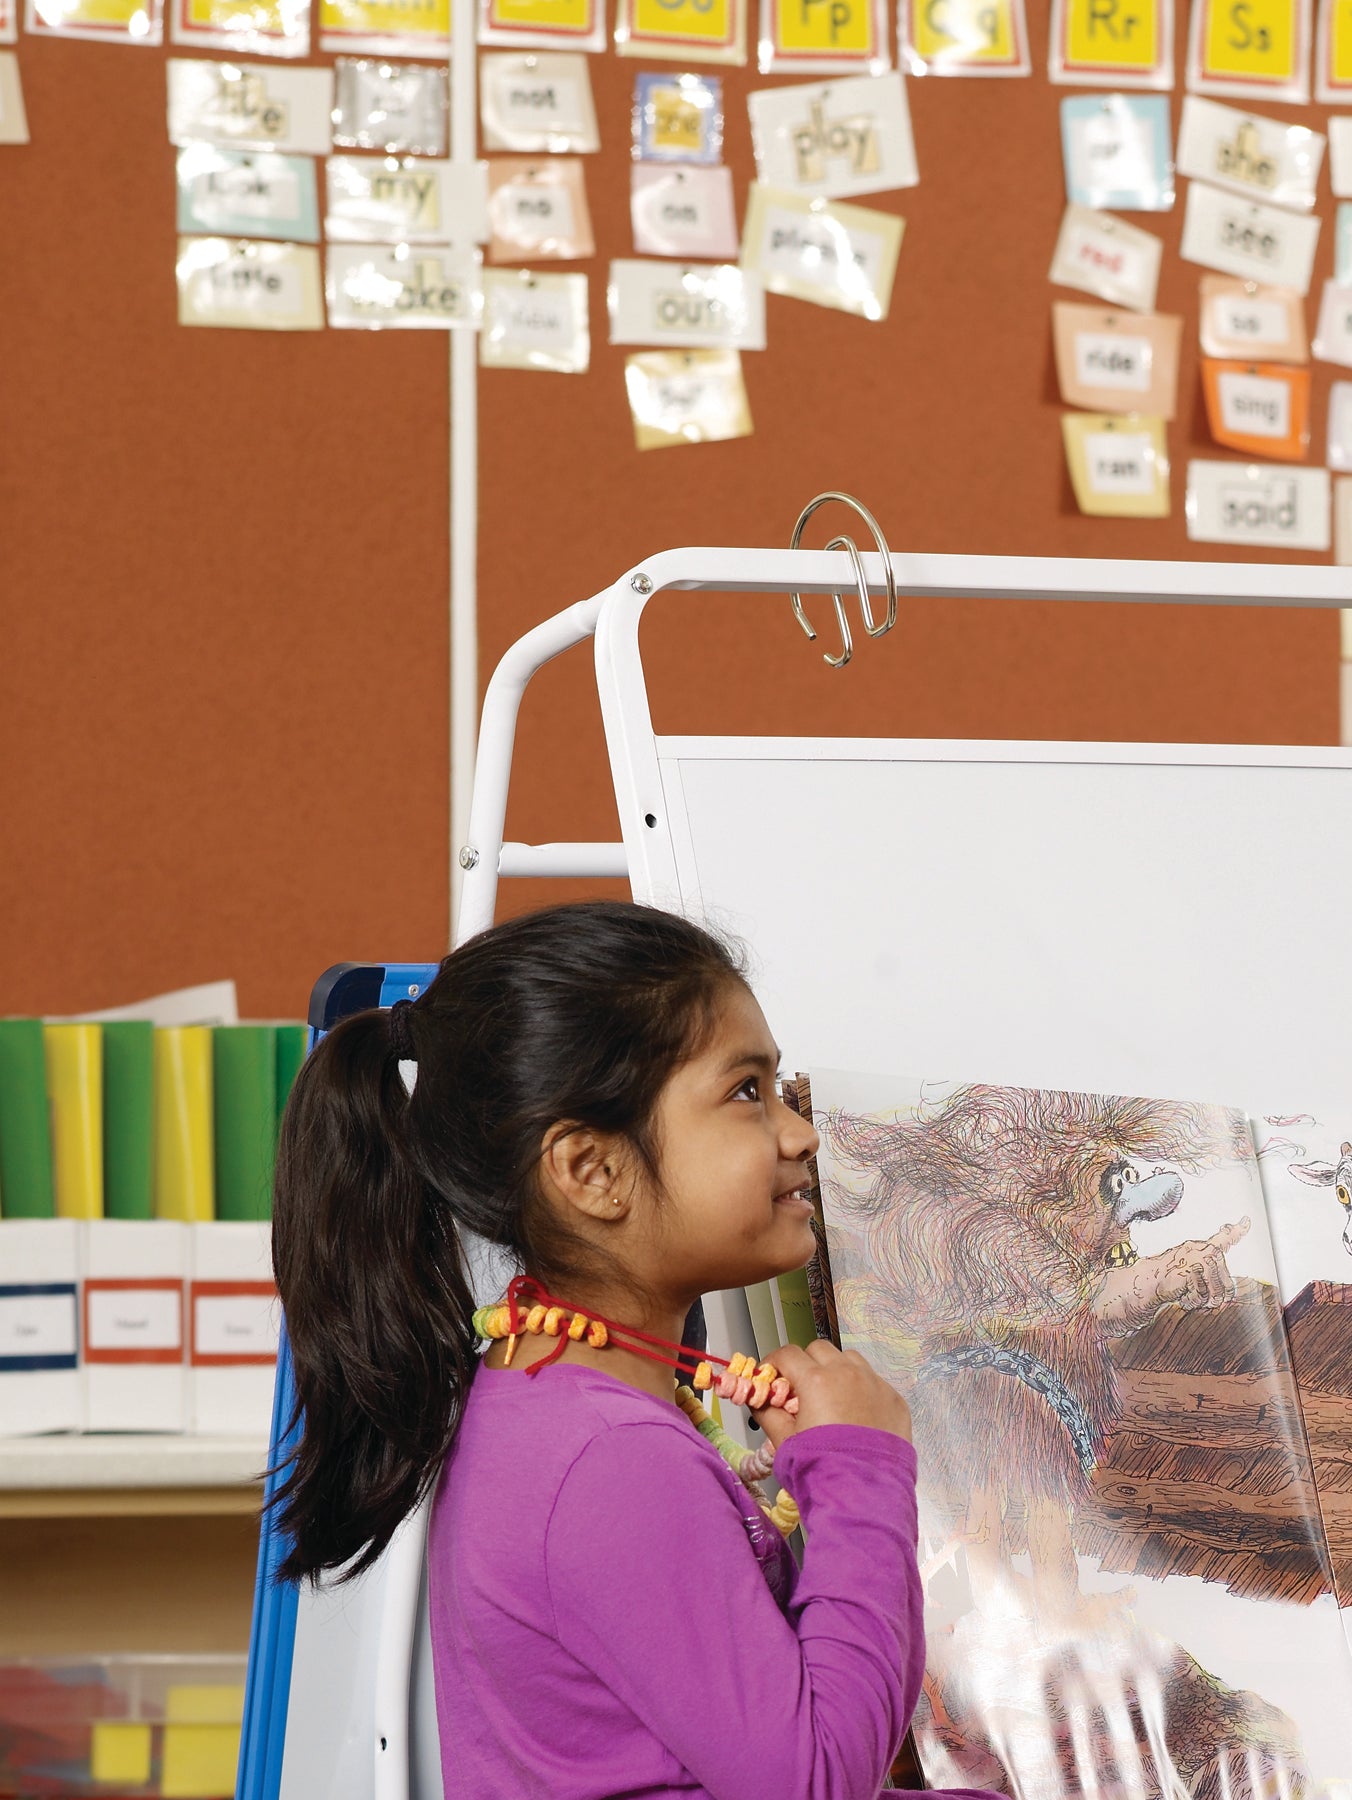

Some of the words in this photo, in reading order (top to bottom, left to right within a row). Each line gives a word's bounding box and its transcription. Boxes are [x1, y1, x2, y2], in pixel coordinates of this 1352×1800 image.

[1087, 0, 1138, 42] Rr
[1229, 3, 1272, 52] Ss
[510, 86, 558, 109] not
[795, 100, 870, 176] play
[1215, 122, 1275, 188] she
[372, 174, 434, 216] my
[516, 199, 552, 217] no
[660, 203, 699, 222] on
[1222, 221, 1278, 254] see
[1080, 243, 1125, 273] red
[1231, 315, 1262, 332] so
[1085, 350, 1136, 375] ride
[1232, 396, 1280, 426] sing
[1097, 459, 1140, 477] ran
[1222, 477, 1298, 528] said
